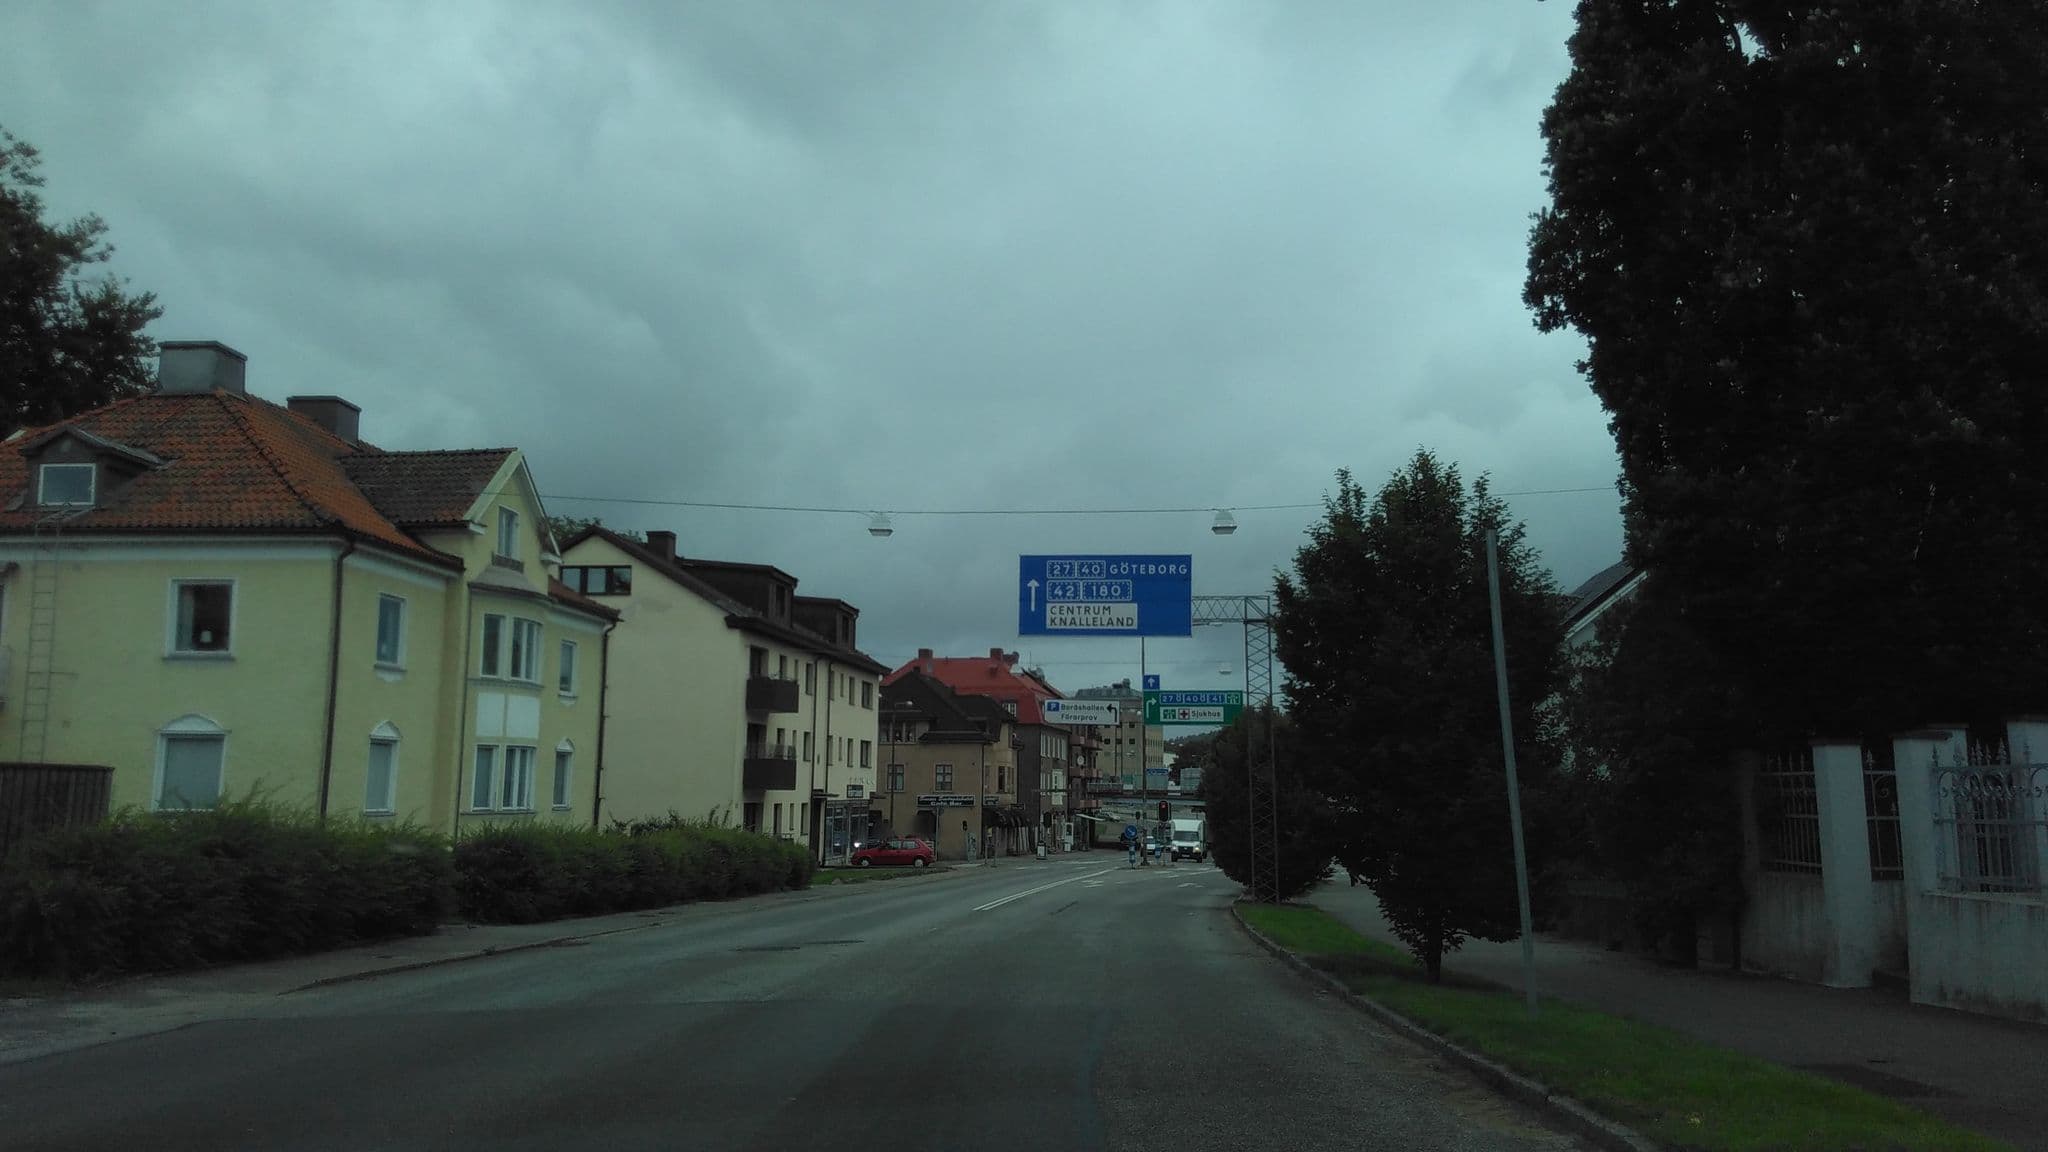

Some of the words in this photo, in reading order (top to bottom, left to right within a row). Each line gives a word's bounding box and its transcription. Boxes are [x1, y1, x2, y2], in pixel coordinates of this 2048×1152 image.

[1053, 565, 1071, 575] 27
[1082, 565, 1101, 575] 40
[1110, 562, 1188, 575] GÖTEBORG
[1054, 586, 1074, 597] 42
[1092, 586, 1121, 597] 180
[1050, 605, 1112, 616] CENTRUM
[1050, 617, 1134, 627] KNALLELAND
[1191, 710, 1220, 719] Sjukhus
